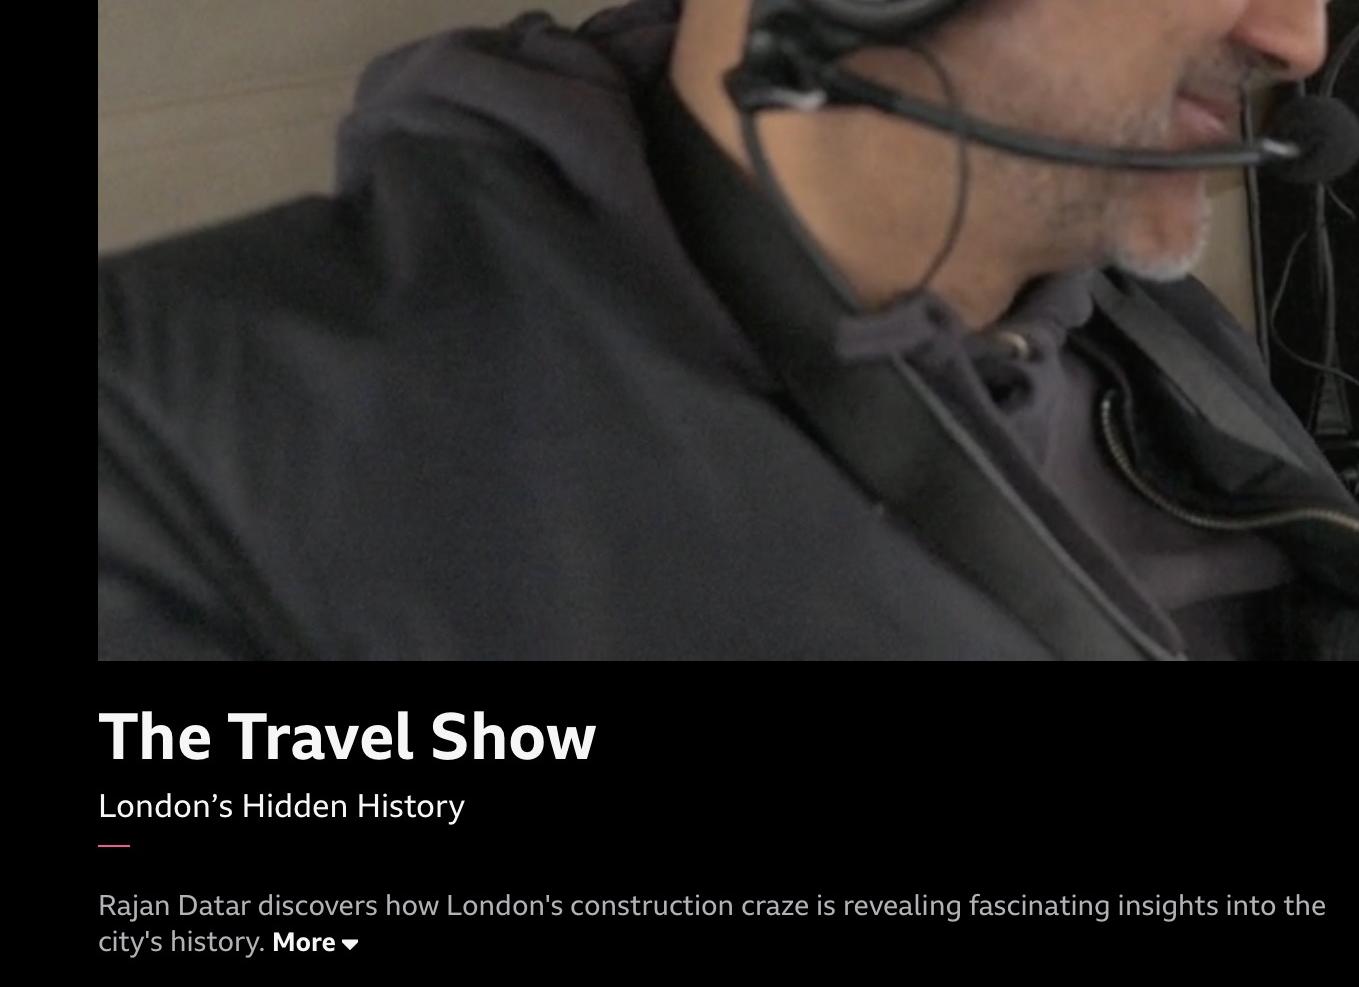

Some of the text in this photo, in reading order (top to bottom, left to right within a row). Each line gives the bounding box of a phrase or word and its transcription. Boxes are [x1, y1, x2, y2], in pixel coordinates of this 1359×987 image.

[98, 710, 597, 761] The Travel Show
[100, 792, 466, 826] London’s Hidden History
[99, 893, 1326, 923] Rajan Datar discovers how London's construction craze is revealing fascinating insights into the
[98, 929, 336, 959] city's history. More
